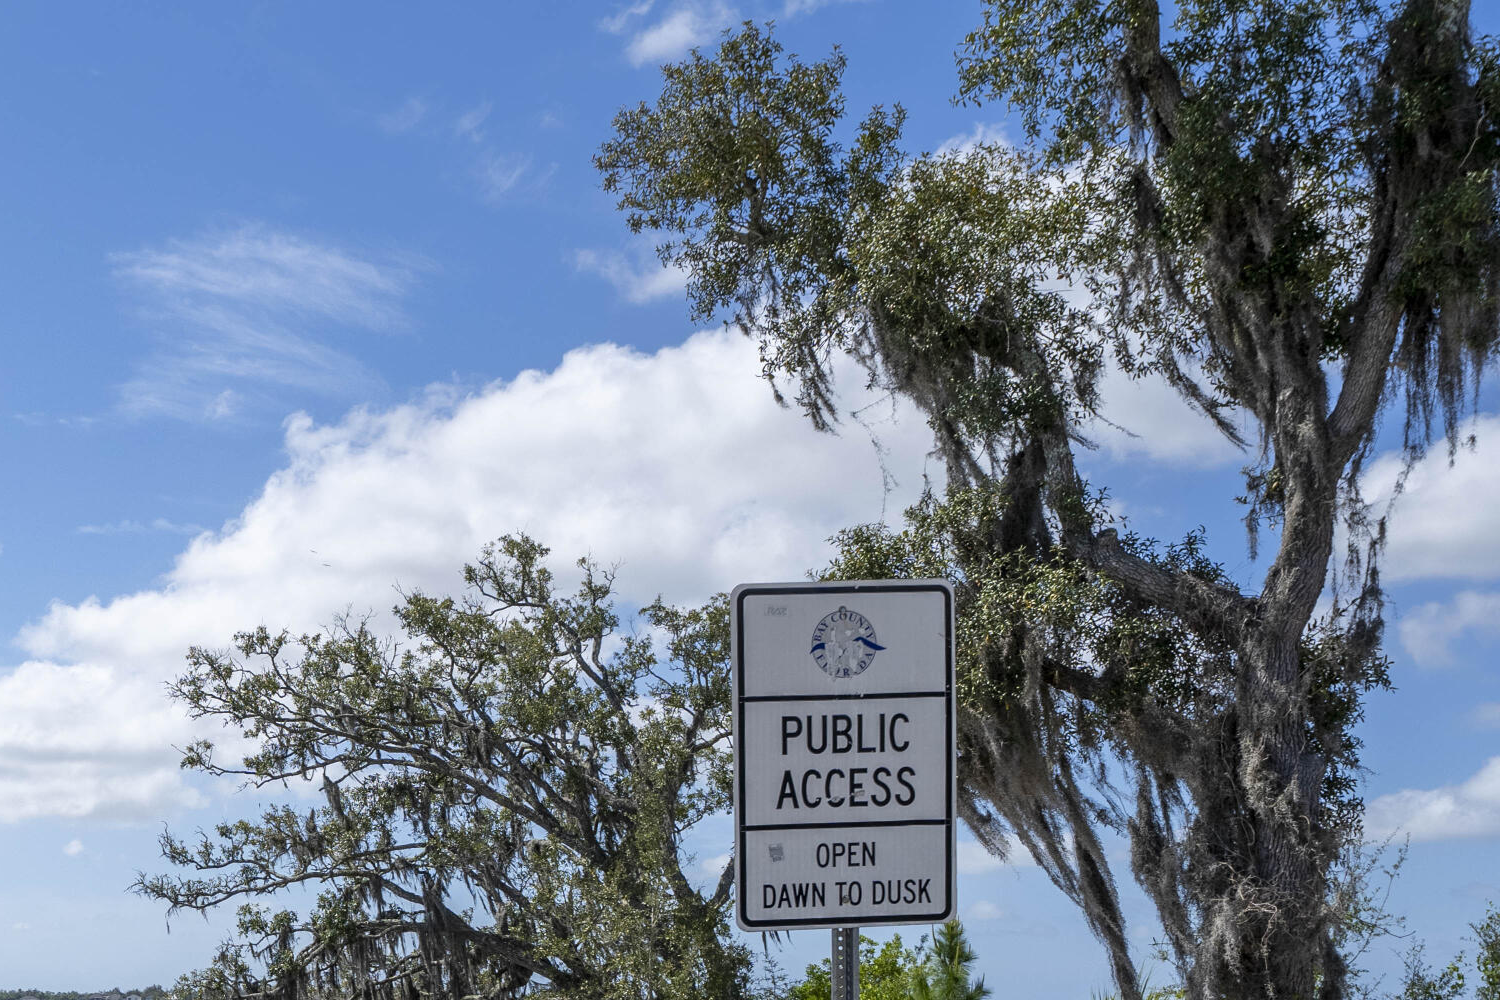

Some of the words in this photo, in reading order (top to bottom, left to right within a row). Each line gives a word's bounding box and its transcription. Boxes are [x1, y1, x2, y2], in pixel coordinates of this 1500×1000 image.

[813, 619, 829, 642] BAY
[830, 612, 875, 639] COUNTY
[816, 653, 873, 677] FLRDA
[781, 713, 910, 755] PUBLIC
[776, 766, 916, 810] ACCESS
[816, 841, 876, 867] OPEN
[762, 882, 826, 909] DAWN
[835, 880, 862, 906] TO
[872, 878, 931, 905] DUSK
